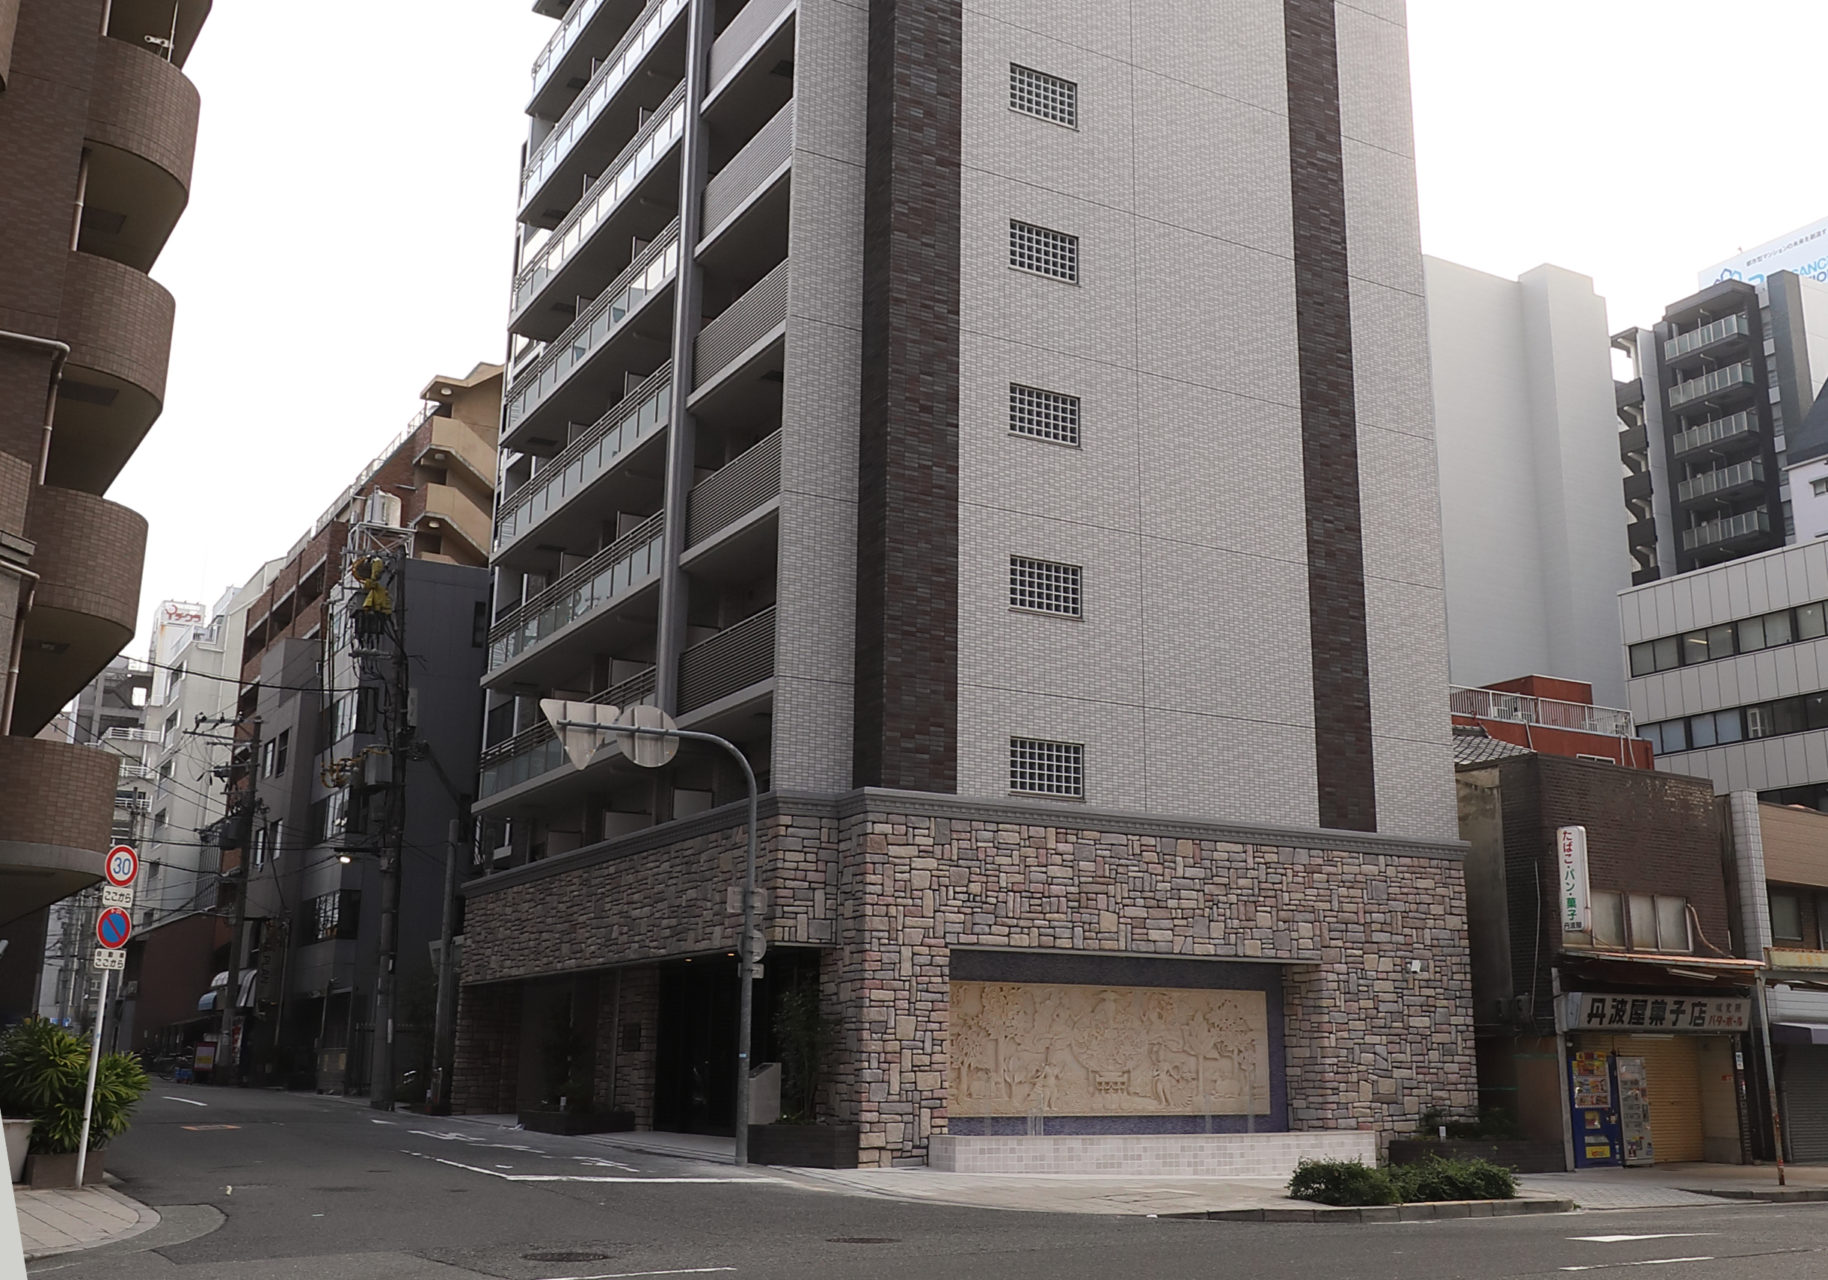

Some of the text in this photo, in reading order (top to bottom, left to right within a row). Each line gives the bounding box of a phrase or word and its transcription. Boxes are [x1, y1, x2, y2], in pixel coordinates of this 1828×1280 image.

[113, 856, 132, 876] 30
[104, 890, 132, 904] ここから
[95, 958, 124, 968] ここから
[1587, 998, 1708, 1027] 丹波屋菓子店
